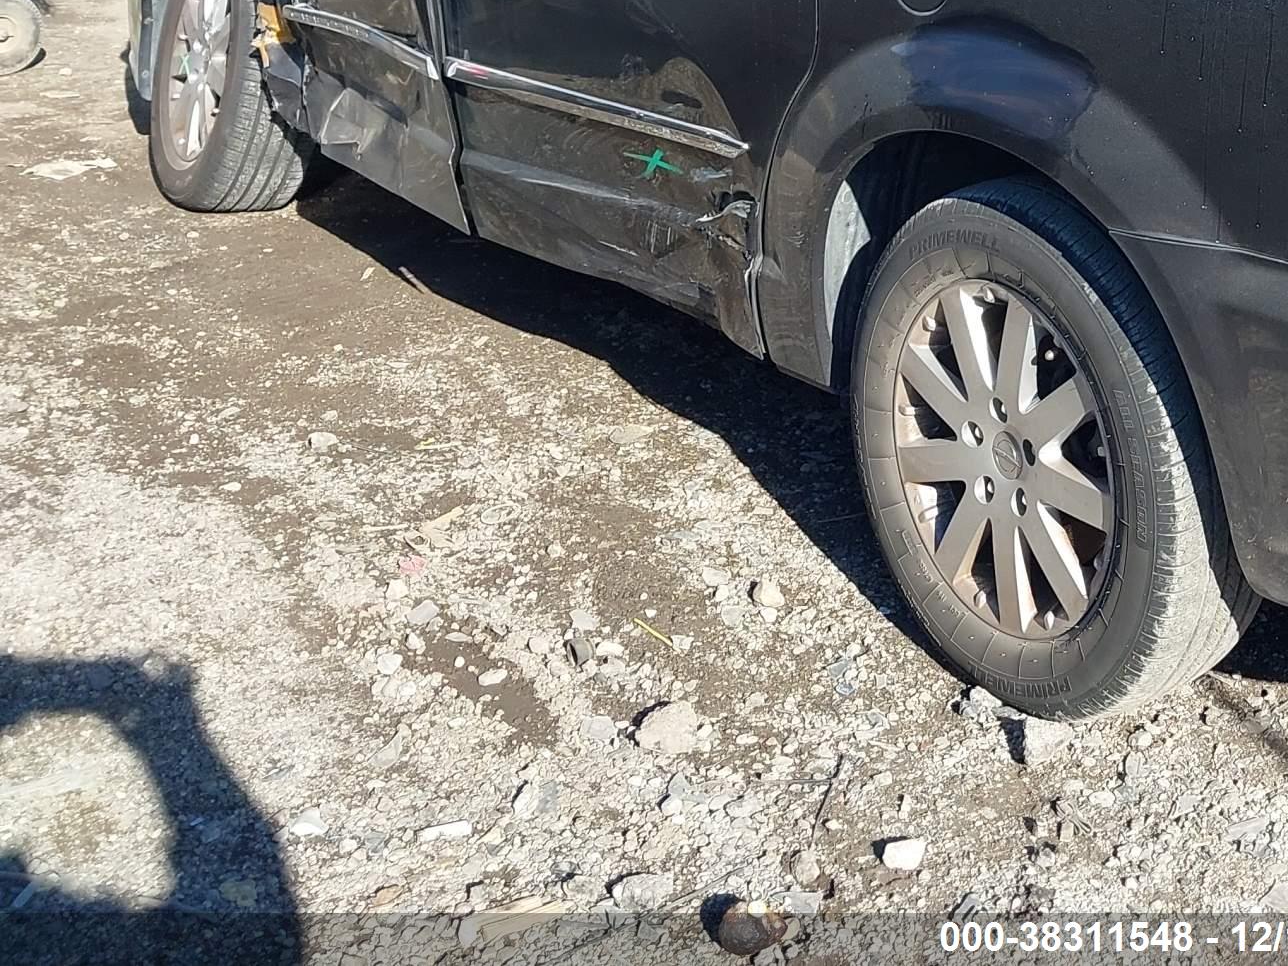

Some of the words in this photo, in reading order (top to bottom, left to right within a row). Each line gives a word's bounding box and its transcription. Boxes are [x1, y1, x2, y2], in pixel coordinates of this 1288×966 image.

[909, 228, 1000, 261] PRIMEWELL
[1112, 389, 1135, 431] ALL
[1127, 437, 1148, 543] SEASON
[968, 660, 1073, 699] PRIMEWELL
